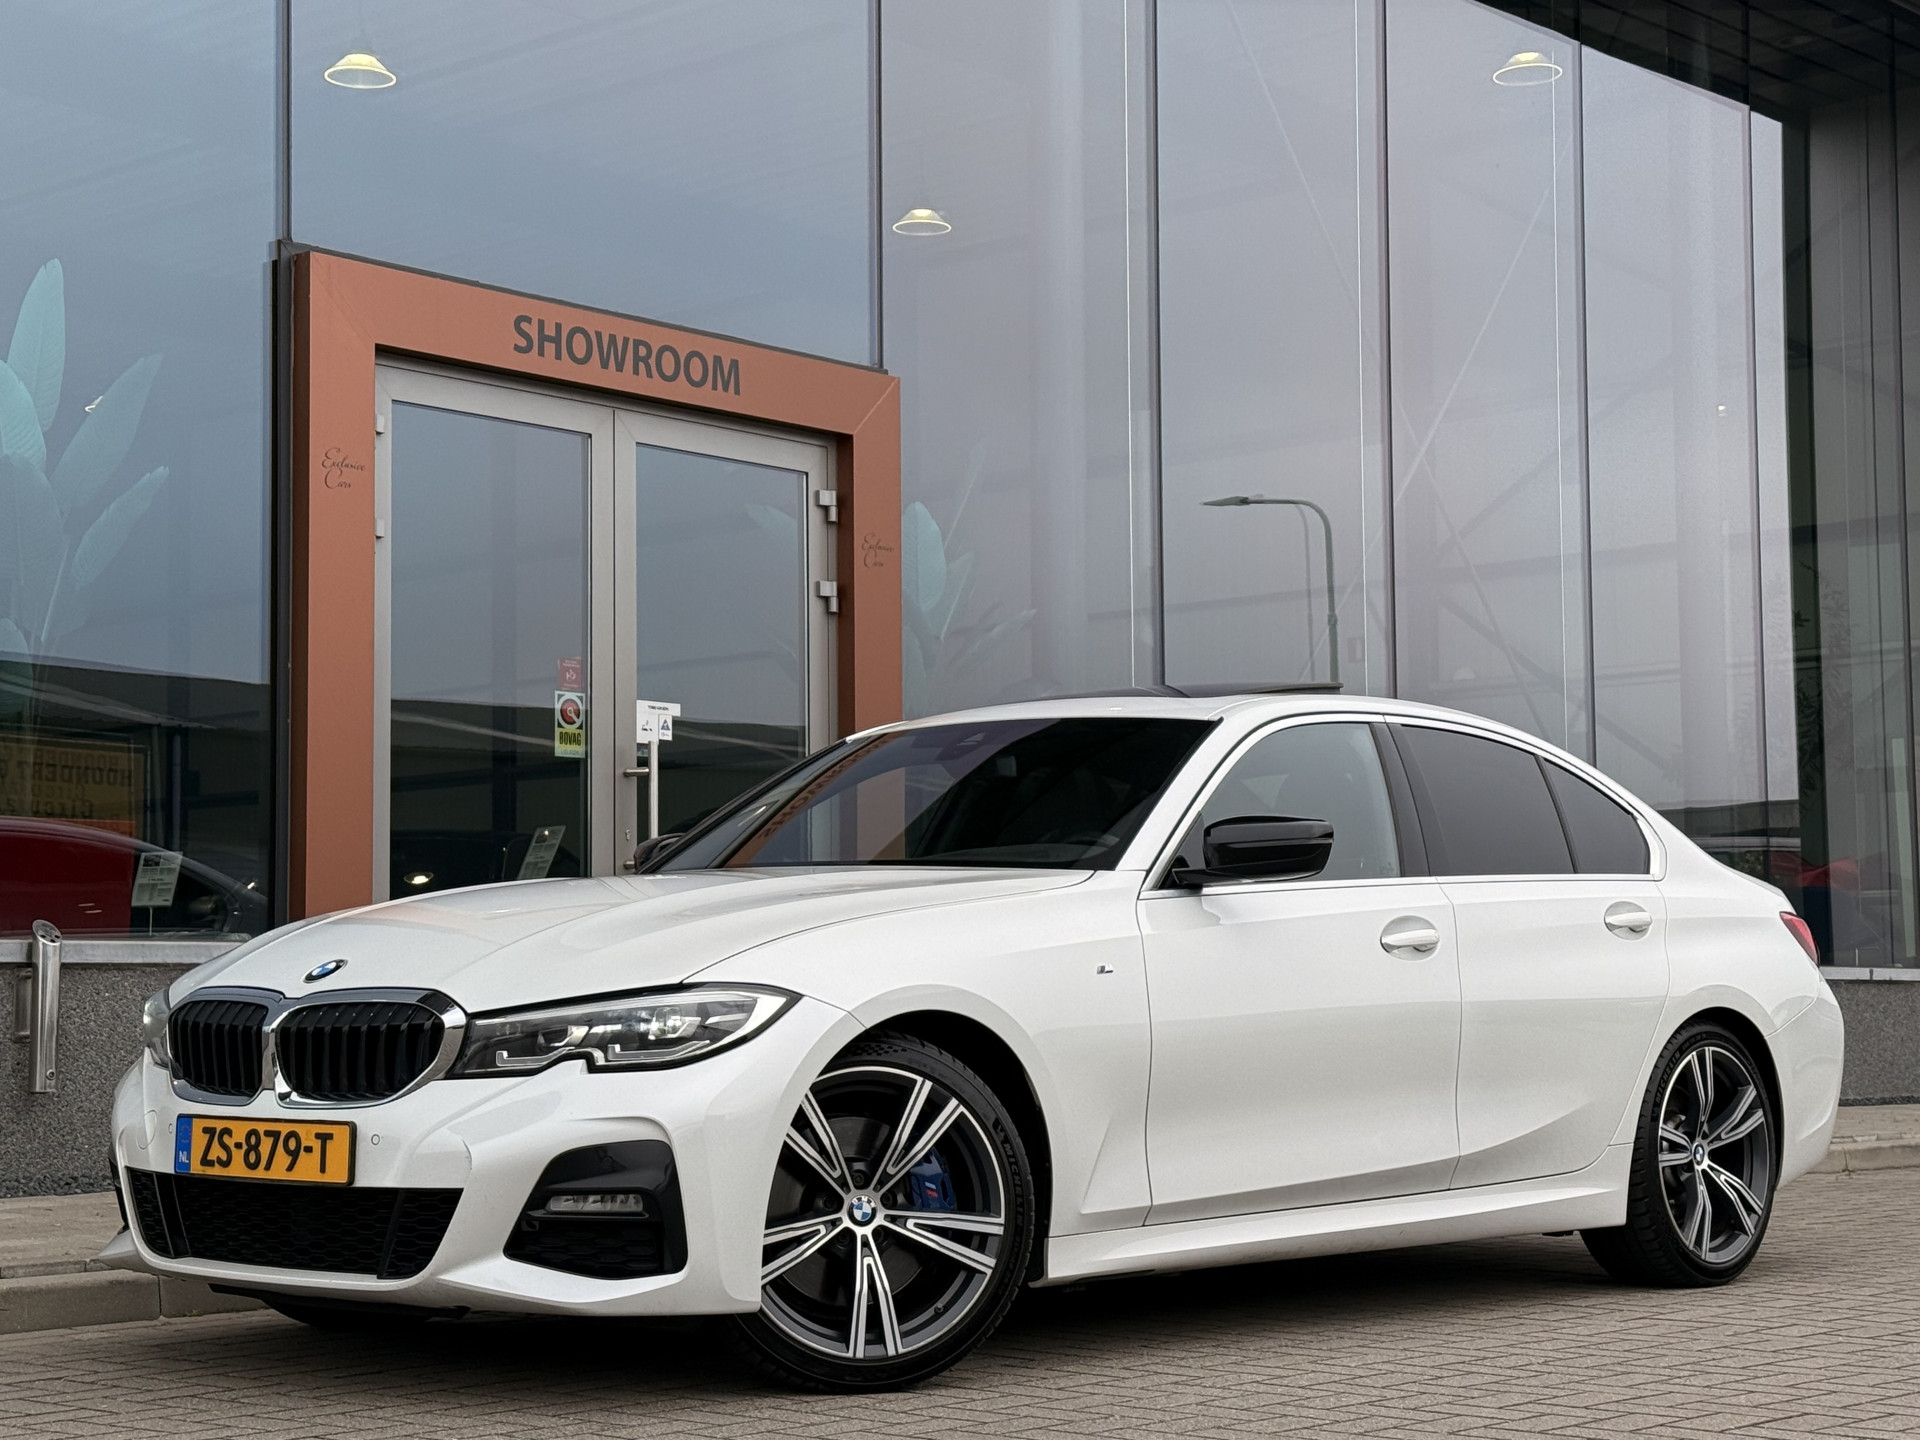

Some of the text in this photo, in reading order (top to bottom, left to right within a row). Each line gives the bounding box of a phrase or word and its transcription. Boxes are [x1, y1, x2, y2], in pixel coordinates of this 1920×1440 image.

[513, 314, 741, 396] SHOWROOM
[322, 447, 365, 471] Exclusive
[559, 731, 581, 746] BOVAG
[179, 1150, 189, 1163] NL
[201, 1126, 334, 1174] ZS-879-T
[1003, 1142, 1023, 1227] MICHELIN
